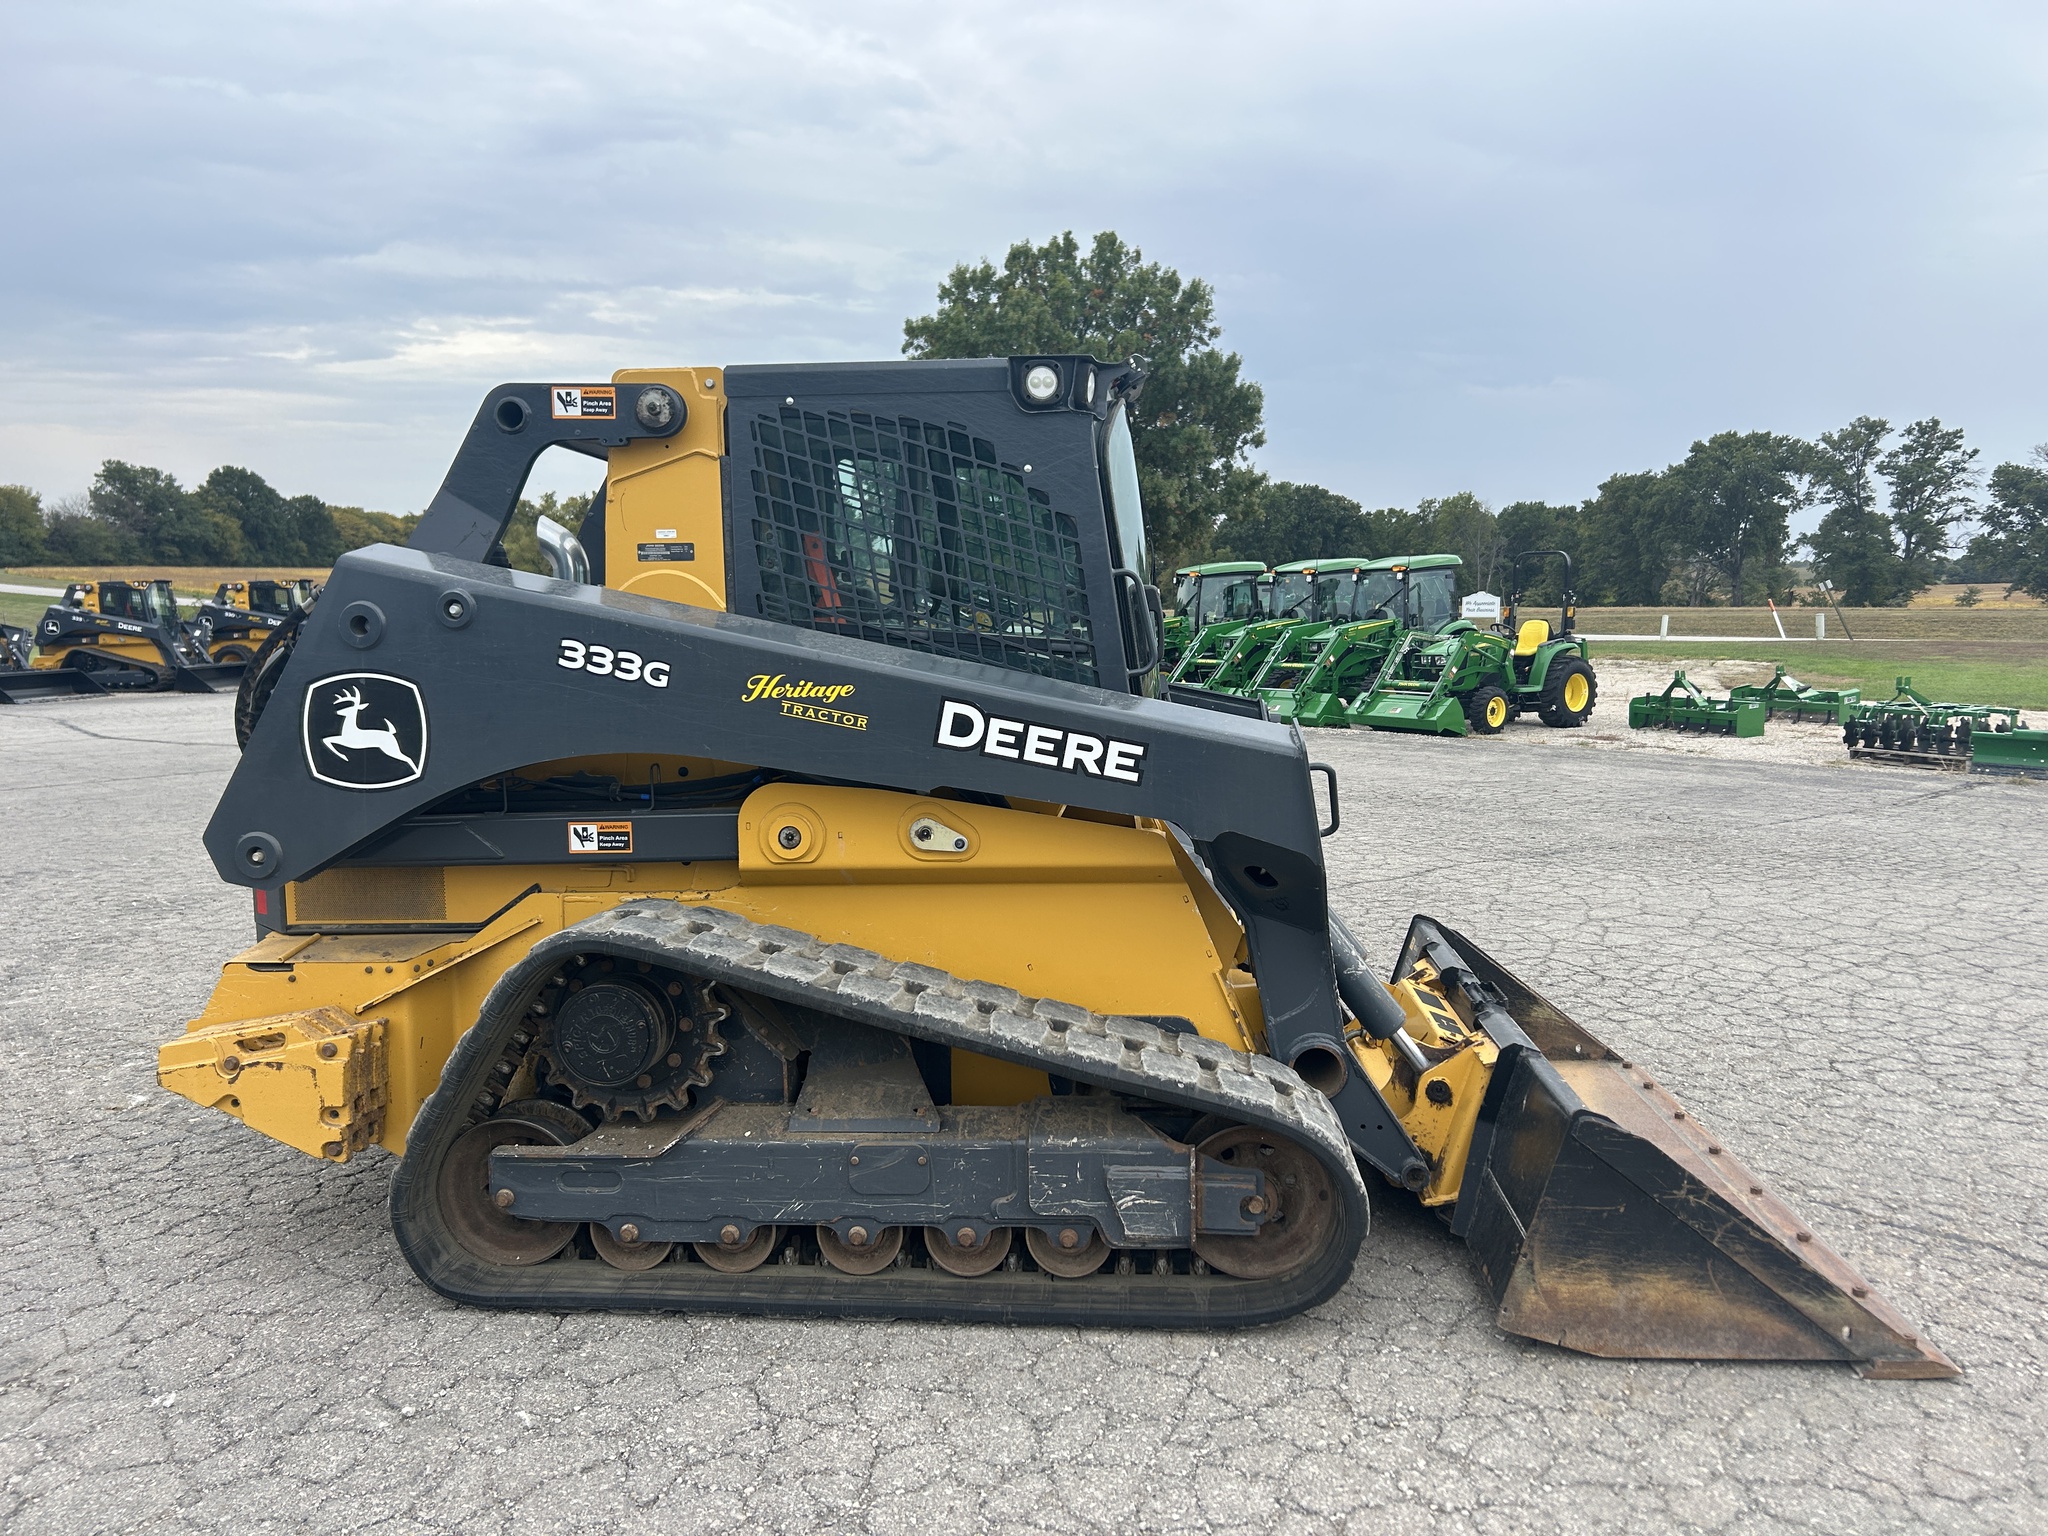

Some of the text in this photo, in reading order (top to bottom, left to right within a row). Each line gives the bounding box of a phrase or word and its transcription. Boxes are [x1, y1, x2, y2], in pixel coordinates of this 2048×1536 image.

[117, 622, 143, 633] DEERE
[558, 639, 671, 688] 333G
[741, 674, 856, 703] Heritage
[781, 702, 868, 728] TRACTOR
[937, 700, 1145, 782] DEERE
